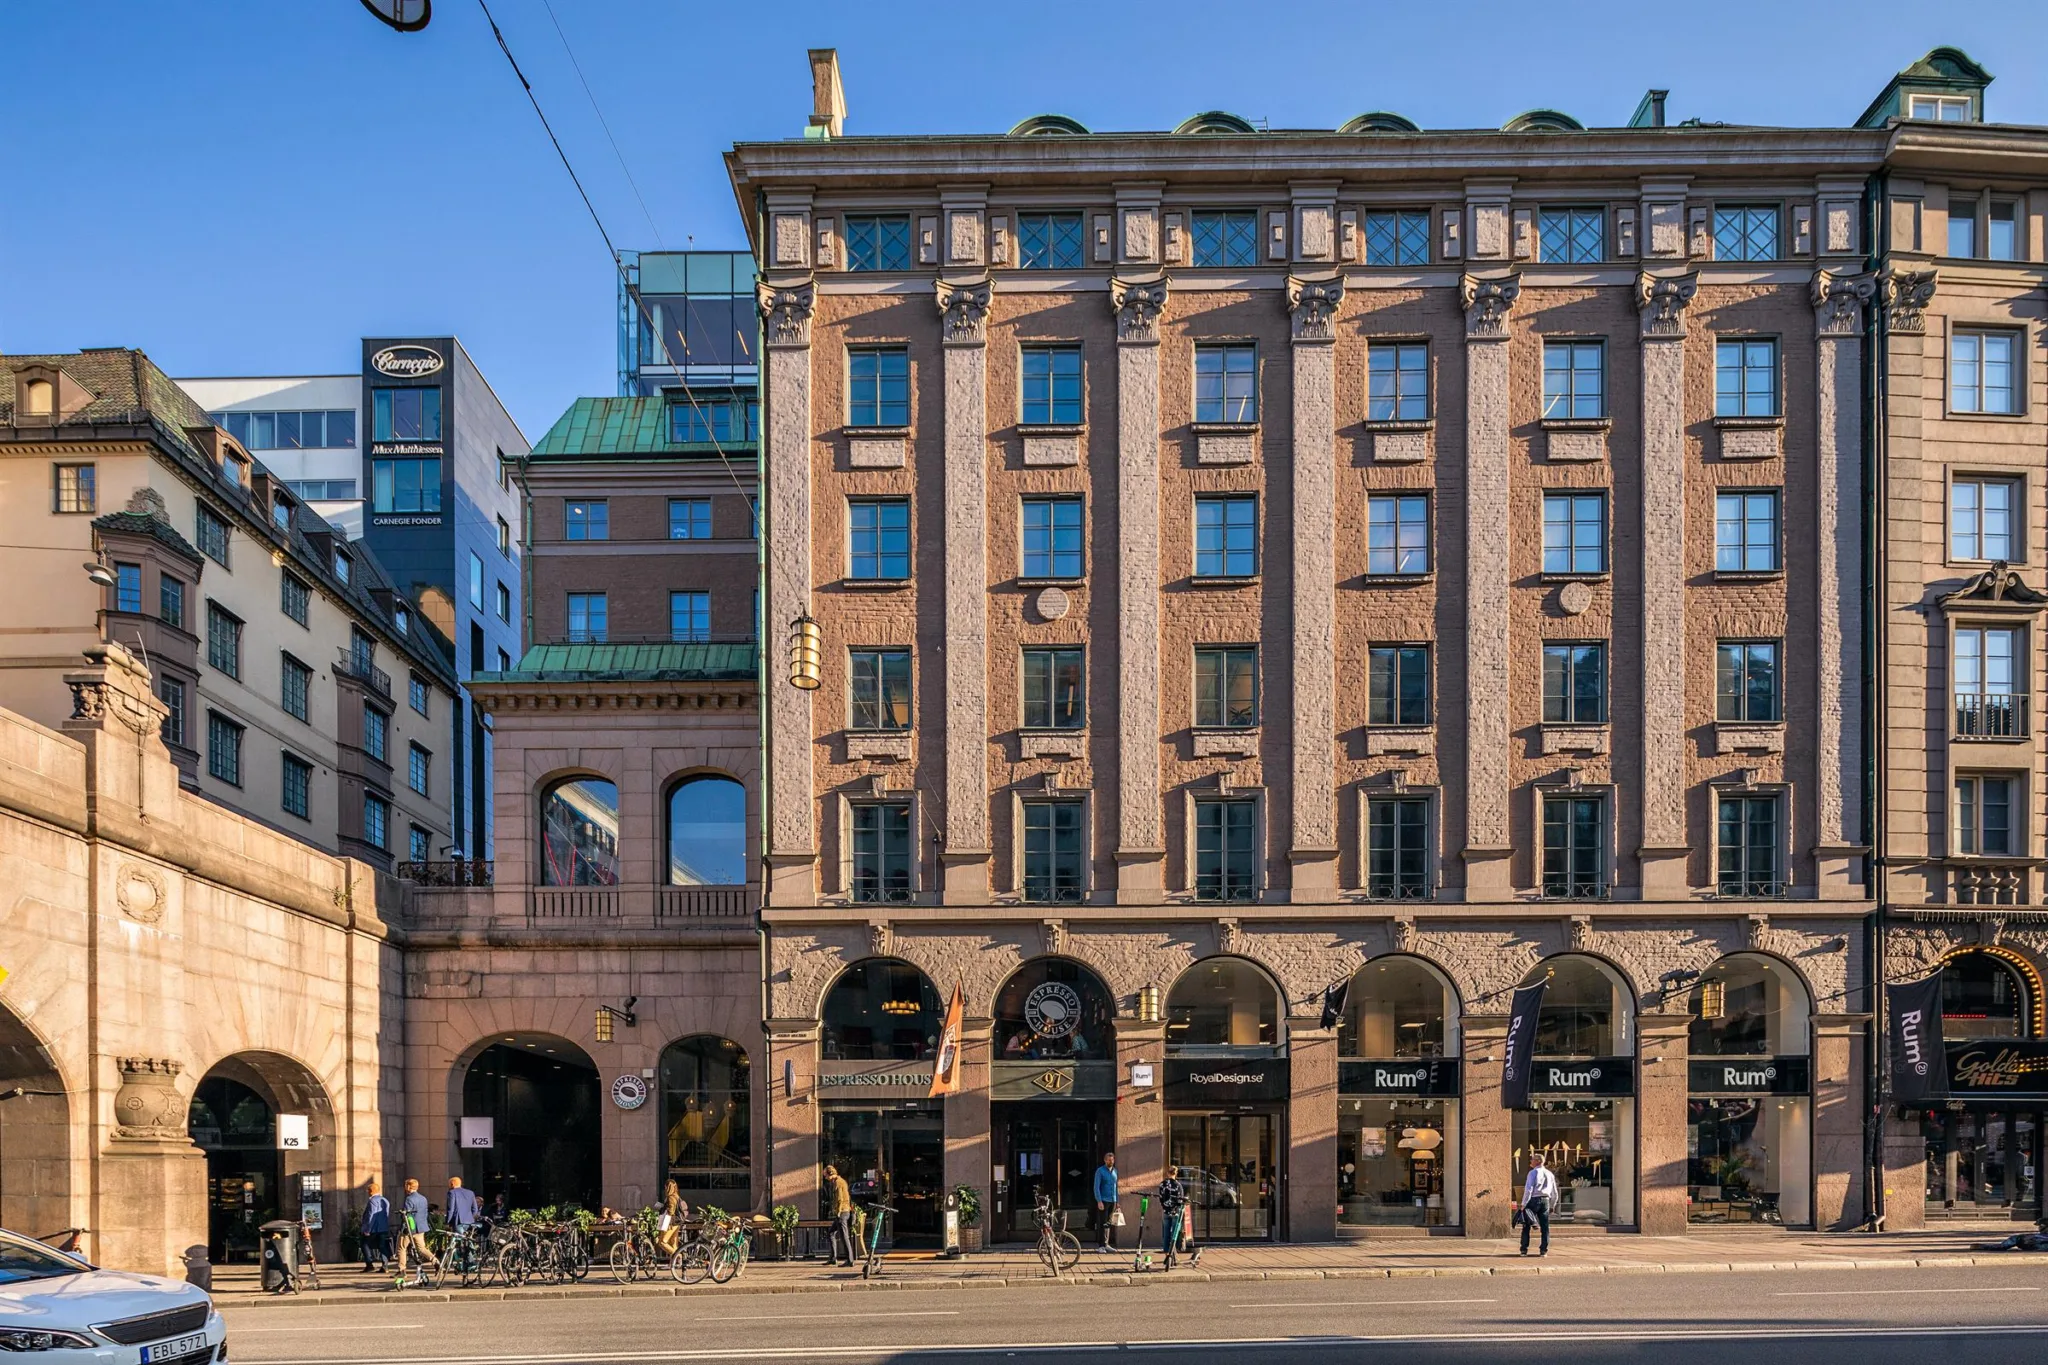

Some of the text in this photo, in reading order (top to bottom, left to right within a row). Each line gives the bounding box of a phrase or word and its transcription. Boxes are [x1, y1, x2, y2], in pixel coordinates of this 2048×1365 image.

[376, 351, 439, 374] Carnegie
[372, 444, 444, 455] Max Matthiessen
[373, 517, 442, 525] CARNEGIE FONDER
[1030, 985, 1076, 1007] ESPRESSO
[614, 1076, 643, 1090] ESPRESSO
[821, 1073, 934, 1086] ESPRESSO HOUS
[1968, 1072, 2020, 1087] Hits
[284, 1137, 299, 1147] K25
[472, 1137, 489, 1146] K25
[153, 1343, 177, 1359] EBL
